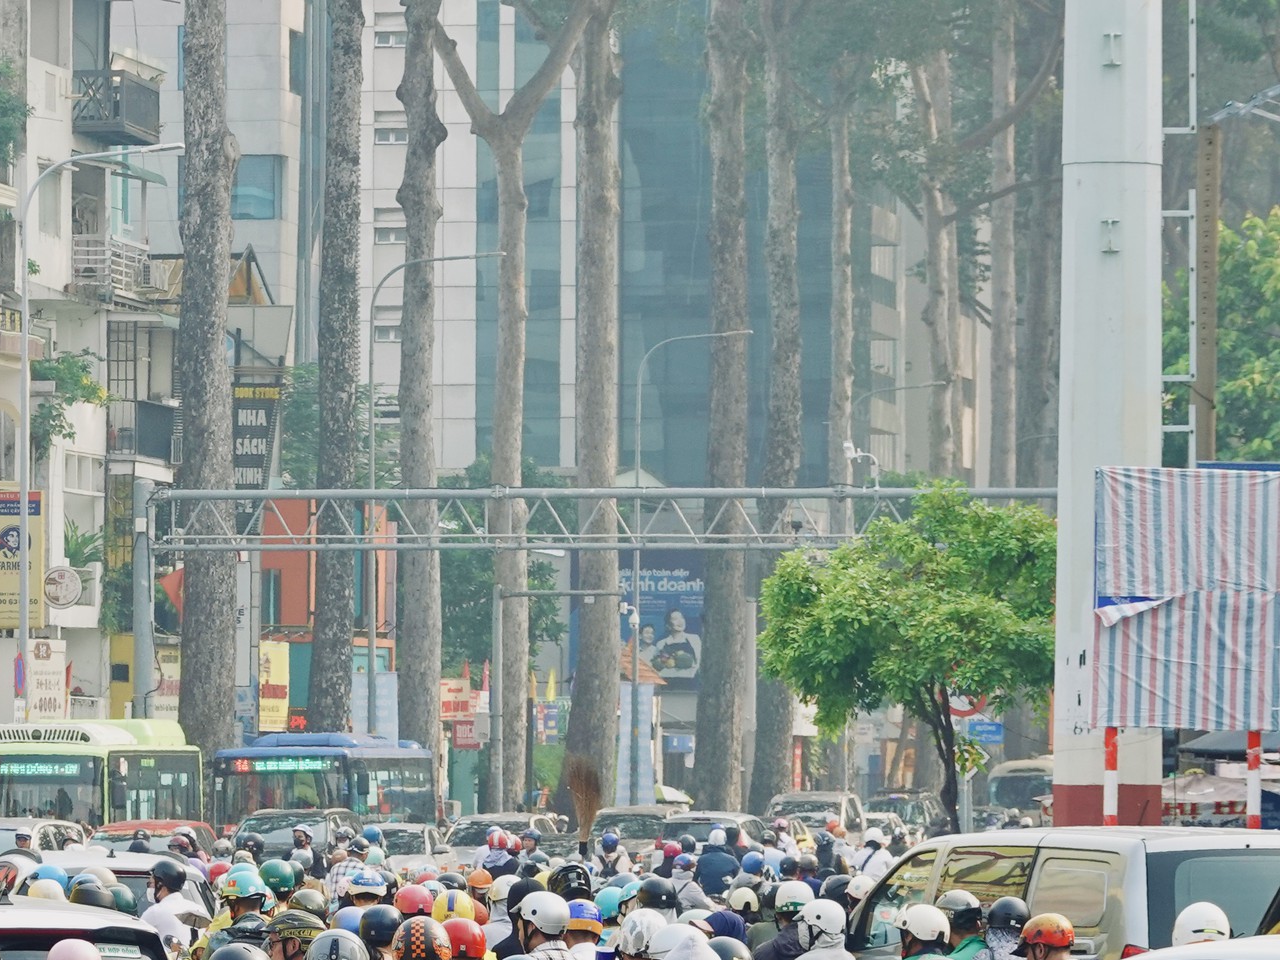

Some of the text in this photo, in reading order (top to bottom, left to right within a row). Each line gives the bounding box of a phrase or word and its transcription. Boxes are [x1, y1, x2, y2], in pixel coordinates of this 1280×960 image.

[235, 434, 267, 455] SÁCH
[234, 467, 263, 484] KINH
[658, 578, 705, 592] doanh
